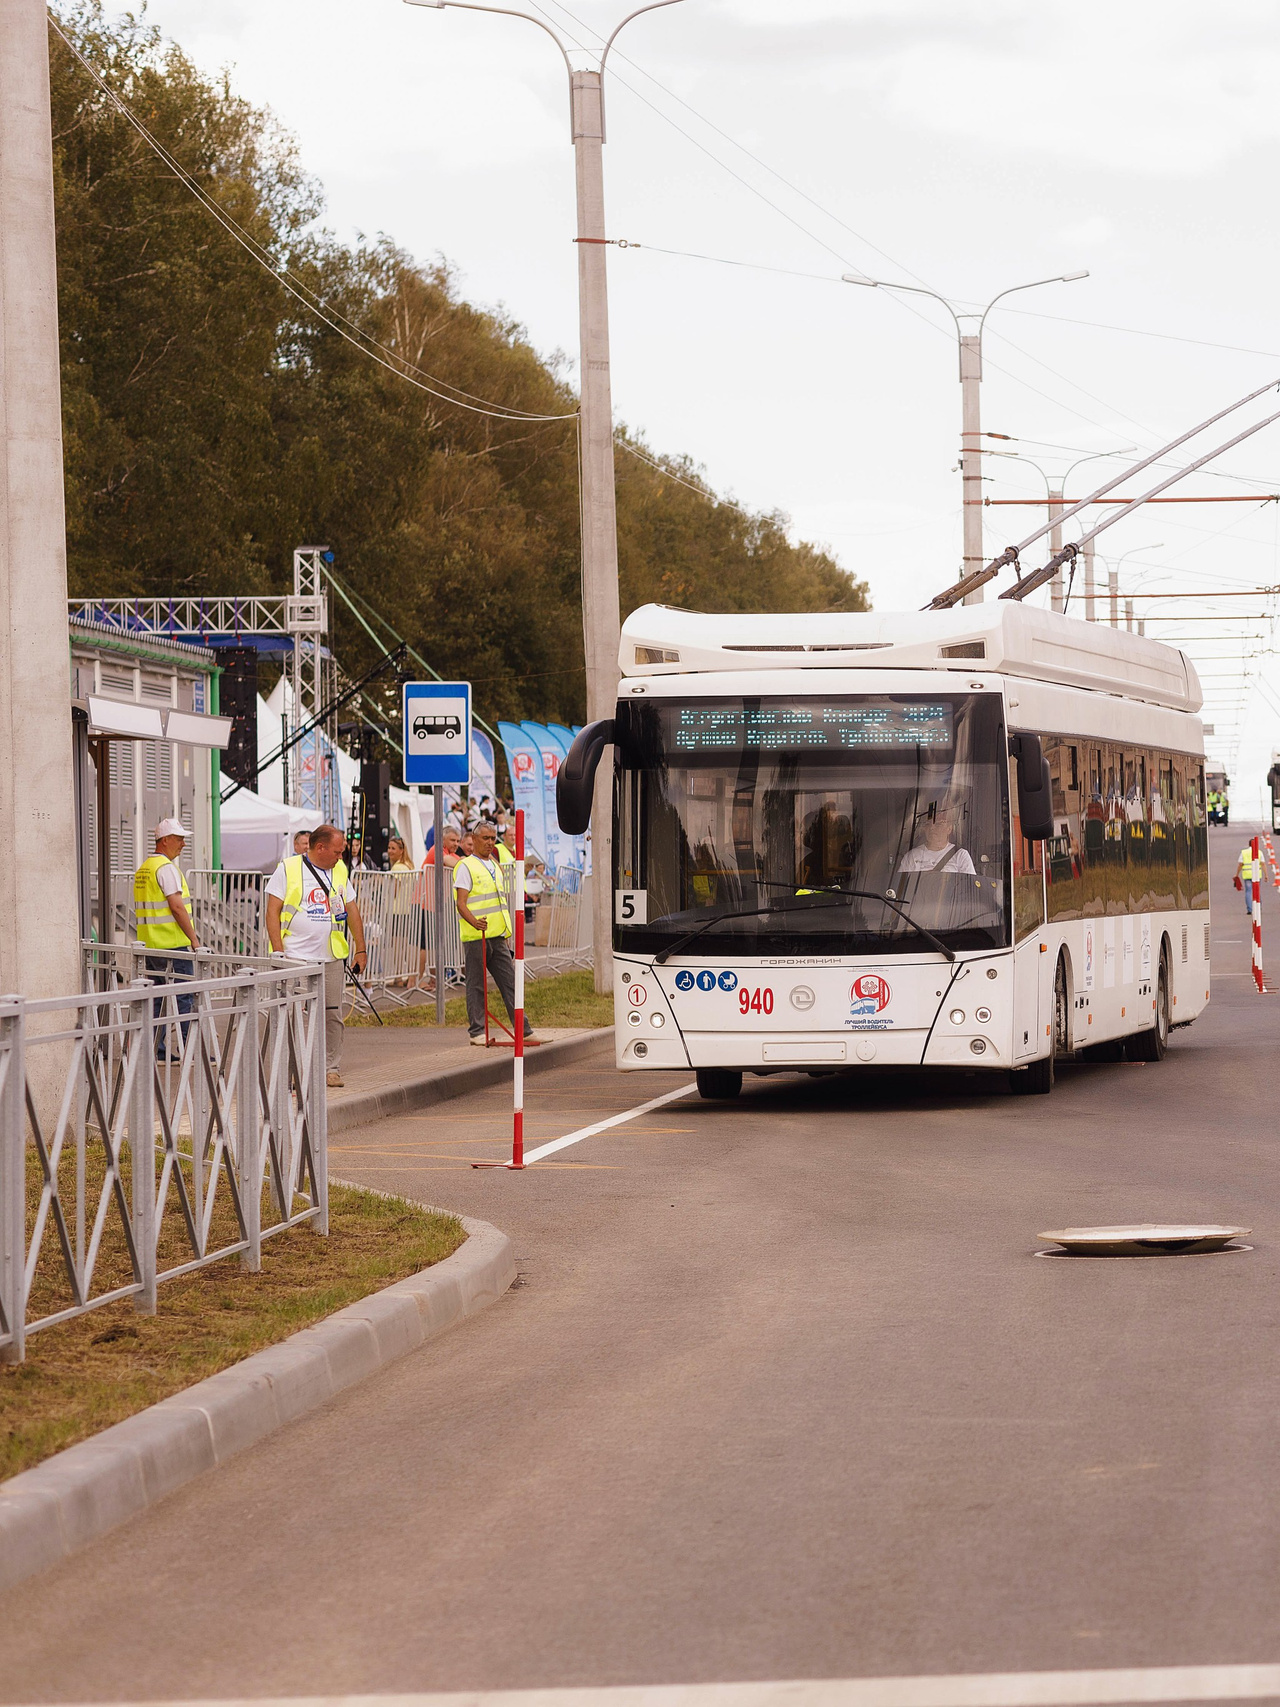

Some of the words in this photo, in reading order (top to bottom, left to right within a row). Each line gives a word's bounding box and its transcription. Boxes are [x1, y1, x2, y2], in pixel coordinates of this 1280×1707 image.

[621, 894, 635, 919] 5
[632, 988, 639, 1003] 1
[738, 987, 774, 1015] 940
